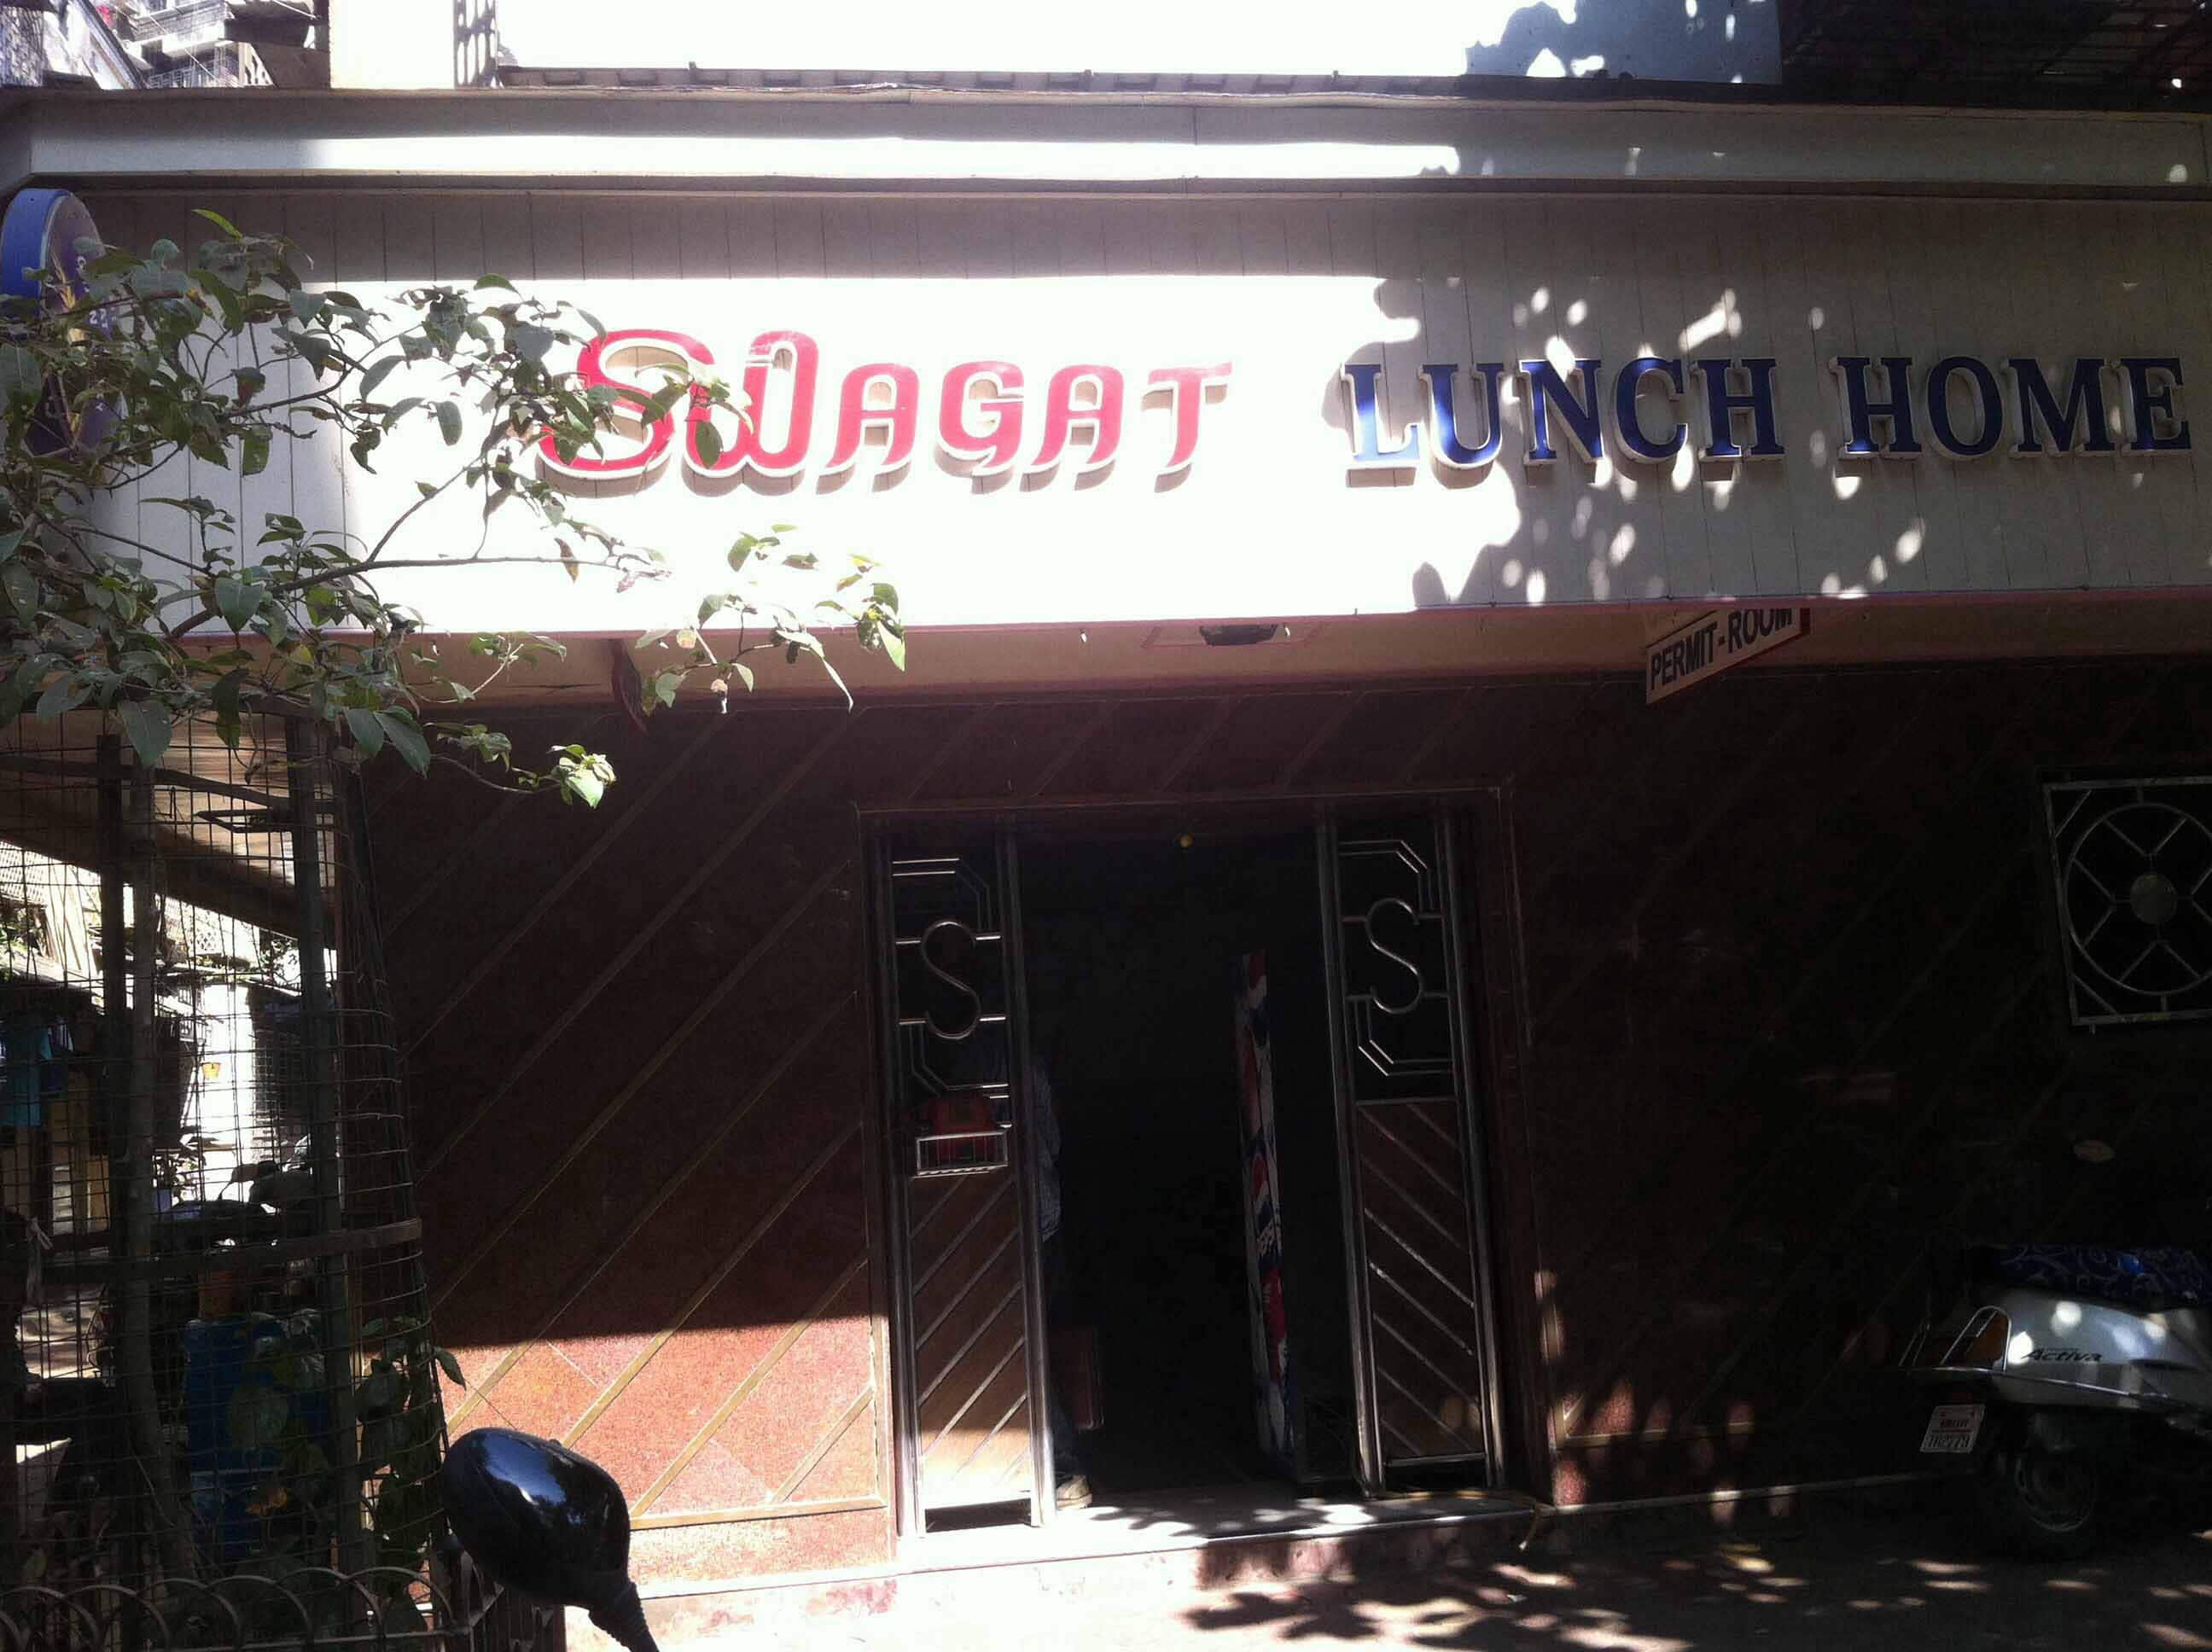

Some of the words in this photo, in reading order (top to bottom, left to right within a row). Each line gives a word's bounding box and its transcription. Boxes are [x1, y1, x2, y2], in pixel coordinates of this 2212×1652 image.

[536, 329, 1233, 478] SWAGAT
[1341, 356, 1785, 469] LUNCH
[1830, 356, 2192, 461] HOME
[2022, 1348, 2103, 1363] Activa
